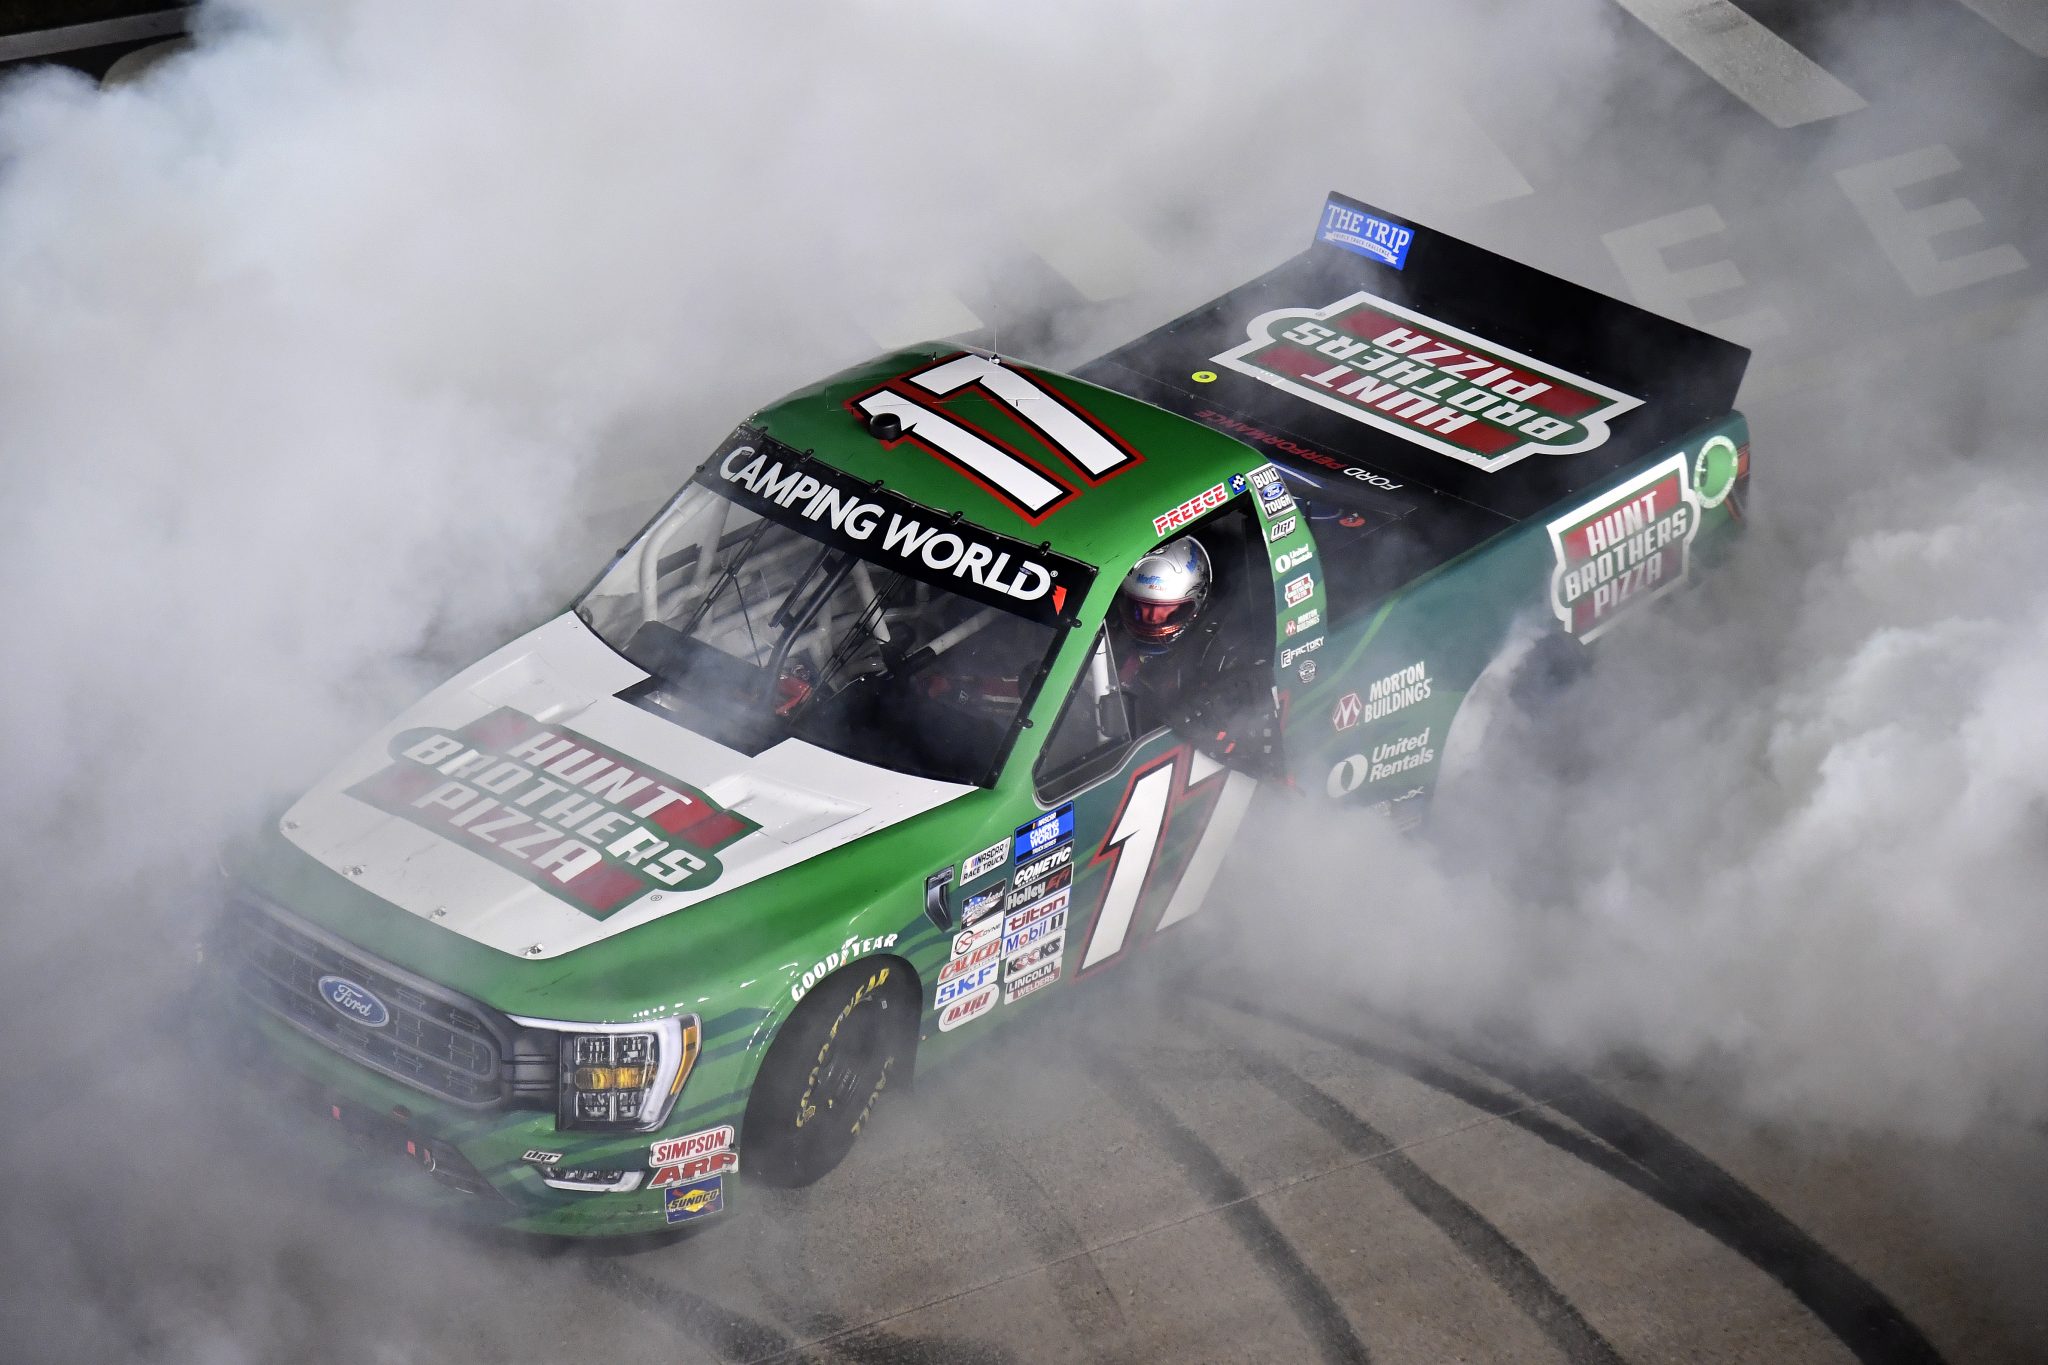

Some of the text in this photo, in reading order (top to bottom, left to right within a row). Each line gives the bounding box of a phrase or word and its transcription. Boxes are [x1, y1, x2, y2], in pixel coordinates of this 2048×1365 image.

[1326, 205, 1410, 254] THE TRIP
[1282, 322, 1575, 441] BROTHERS
[1372, 327, 1552, 402] PIZZA
[1300, 365, 1478, 434] HUNT
[1194, 409, 1404, 491] FORD PERFORMANCE
[720, 446, 883, 540] CAMPING
[1252, 467, 1280, 489] BUILT
[1265, 485, 1282, 498] Ford
[1154, 483, 1228, 537] PREECE
[1265, 494, 1292, 515] TOUGH
[1585, 491, 1657, 556] HUNT
[1564, 508, 1687, 602] BROTHERS
[1594, 552, 1662, 618] PIZZA
[1364, 679, 1432, 723] BUILDINGS
[1370, 661, 1425, 702] MORTON
[1369, 747, 1434, 783] Rentals
[1372, 728, 1430, 764] United
[507, 732, 692, 818] HUNT
[402, 734, 707, 886] BROTHERS
[1029, 819, 1059, 840] CAMPING
[411, 781, 603, 883] PIZZA
[1030, 828, 1060, 848] WORLD
[963, 864, 981, 880] RACE
[983, 854, 1004, 871] TRUCK
[976, 844, 1004, 865] NASCAR
[1014, 847, 1072, 886] COMETIC
[1007, 880, 1046, 909] Holley
[1008, 895, 1066, 931] tilton
[1005, 921, 1047, 954] Mobil
[1007, 936, 1062, 976] KOOKS
[791, 933, 898, 1002] GOODYEAR
[940, 940, 1000, 980] CALICO
[1008, 965, 1052, 992] LINCOLN
[333, 984, 372, 1017] Ford
[937, 963, 996, 1004] SKF
[1017, 973, 1056, 998] WELDERS
[657, 1130, 726, 1163] SIMPSON
[651, 1153, 737, 1185] ARP
[670, 1190, 719, 1209] SUNOCO
